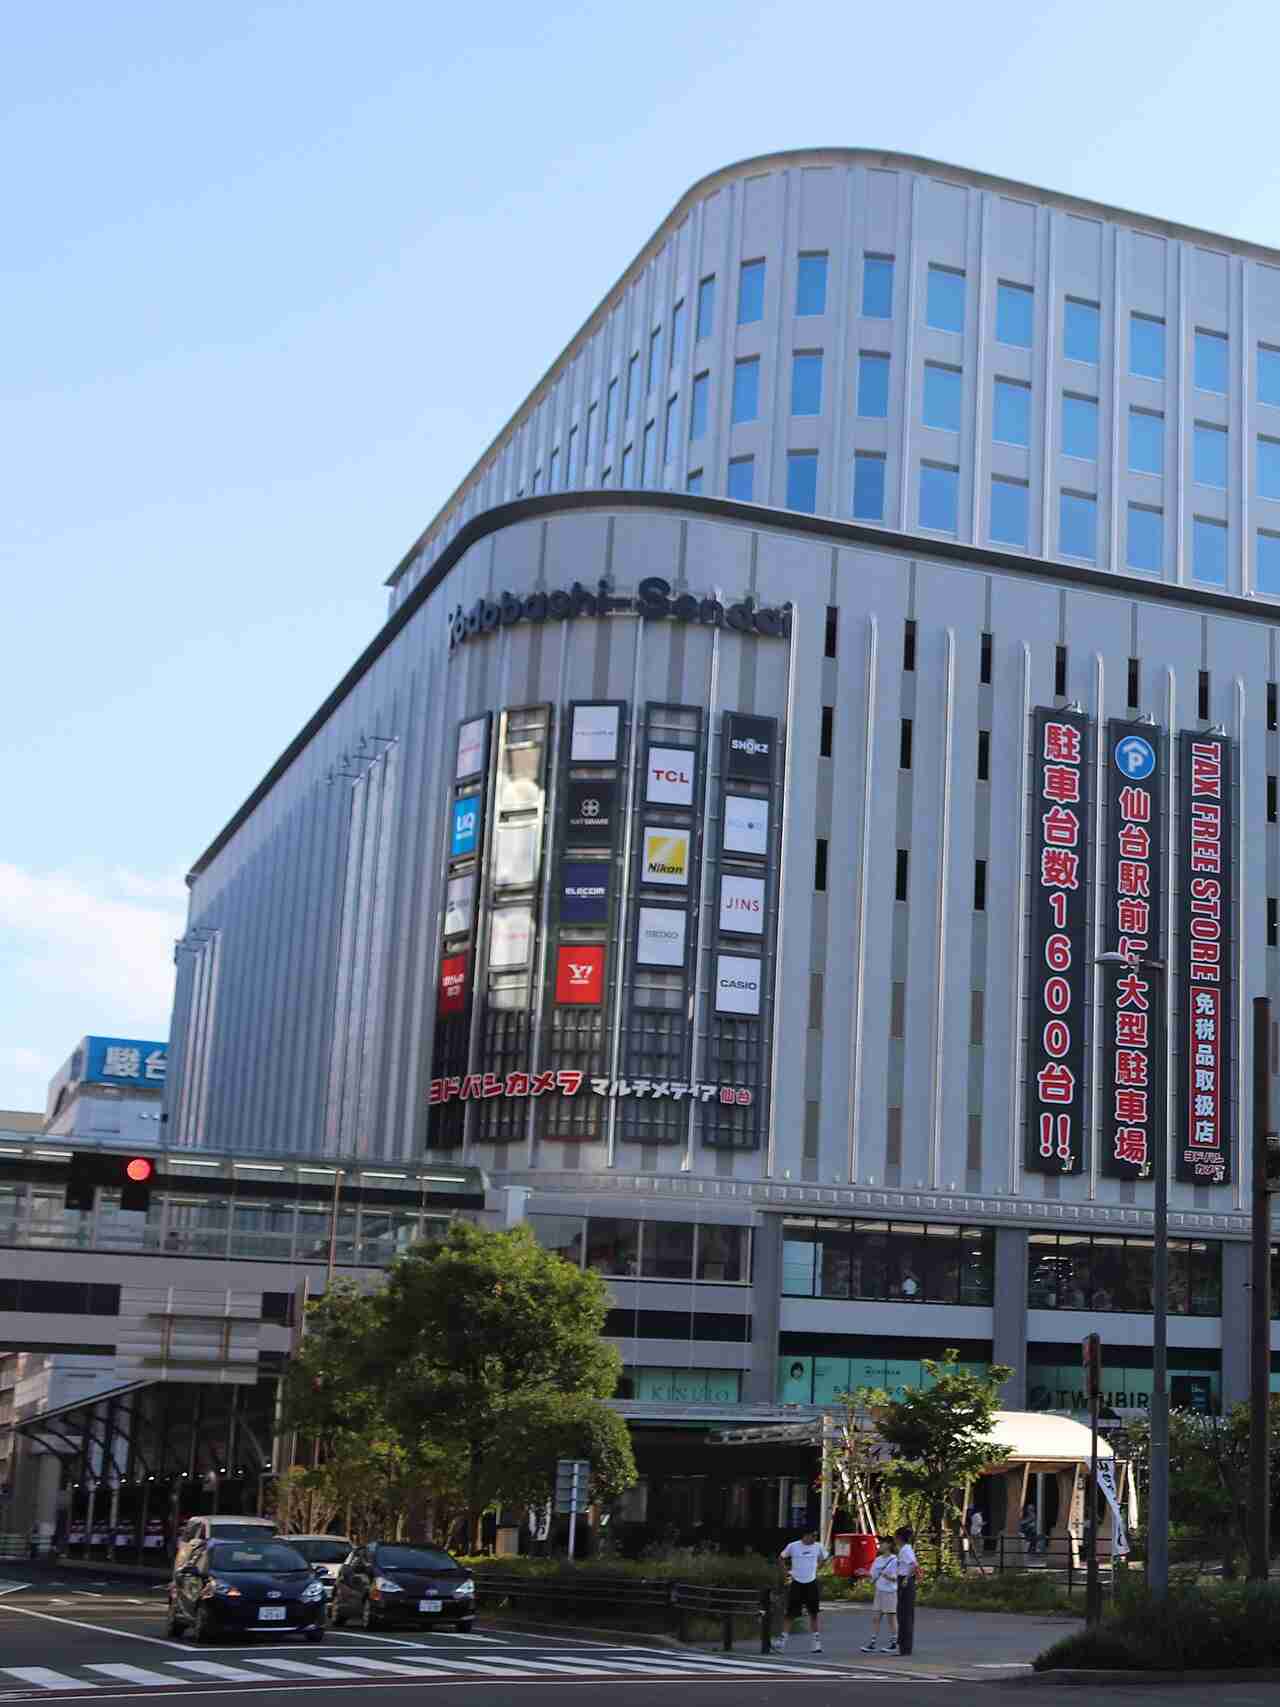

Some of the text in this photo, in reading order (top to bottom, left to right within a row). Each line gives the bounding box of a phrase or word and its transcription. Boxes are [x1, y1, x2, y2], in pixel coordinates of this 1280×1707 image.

[652, 769, 689, 784] TCL
[647, 861, 684, 876] Nikon
[1190, 742, 1221, 983] TAX FREE STORE
[565, 886, 605, 897] ELECOM
[724, 896, 760, 912] JINS
[719, 978, 757, 992] CASIO
[1194, 993, 1216, 1144] 免税品取扱店
